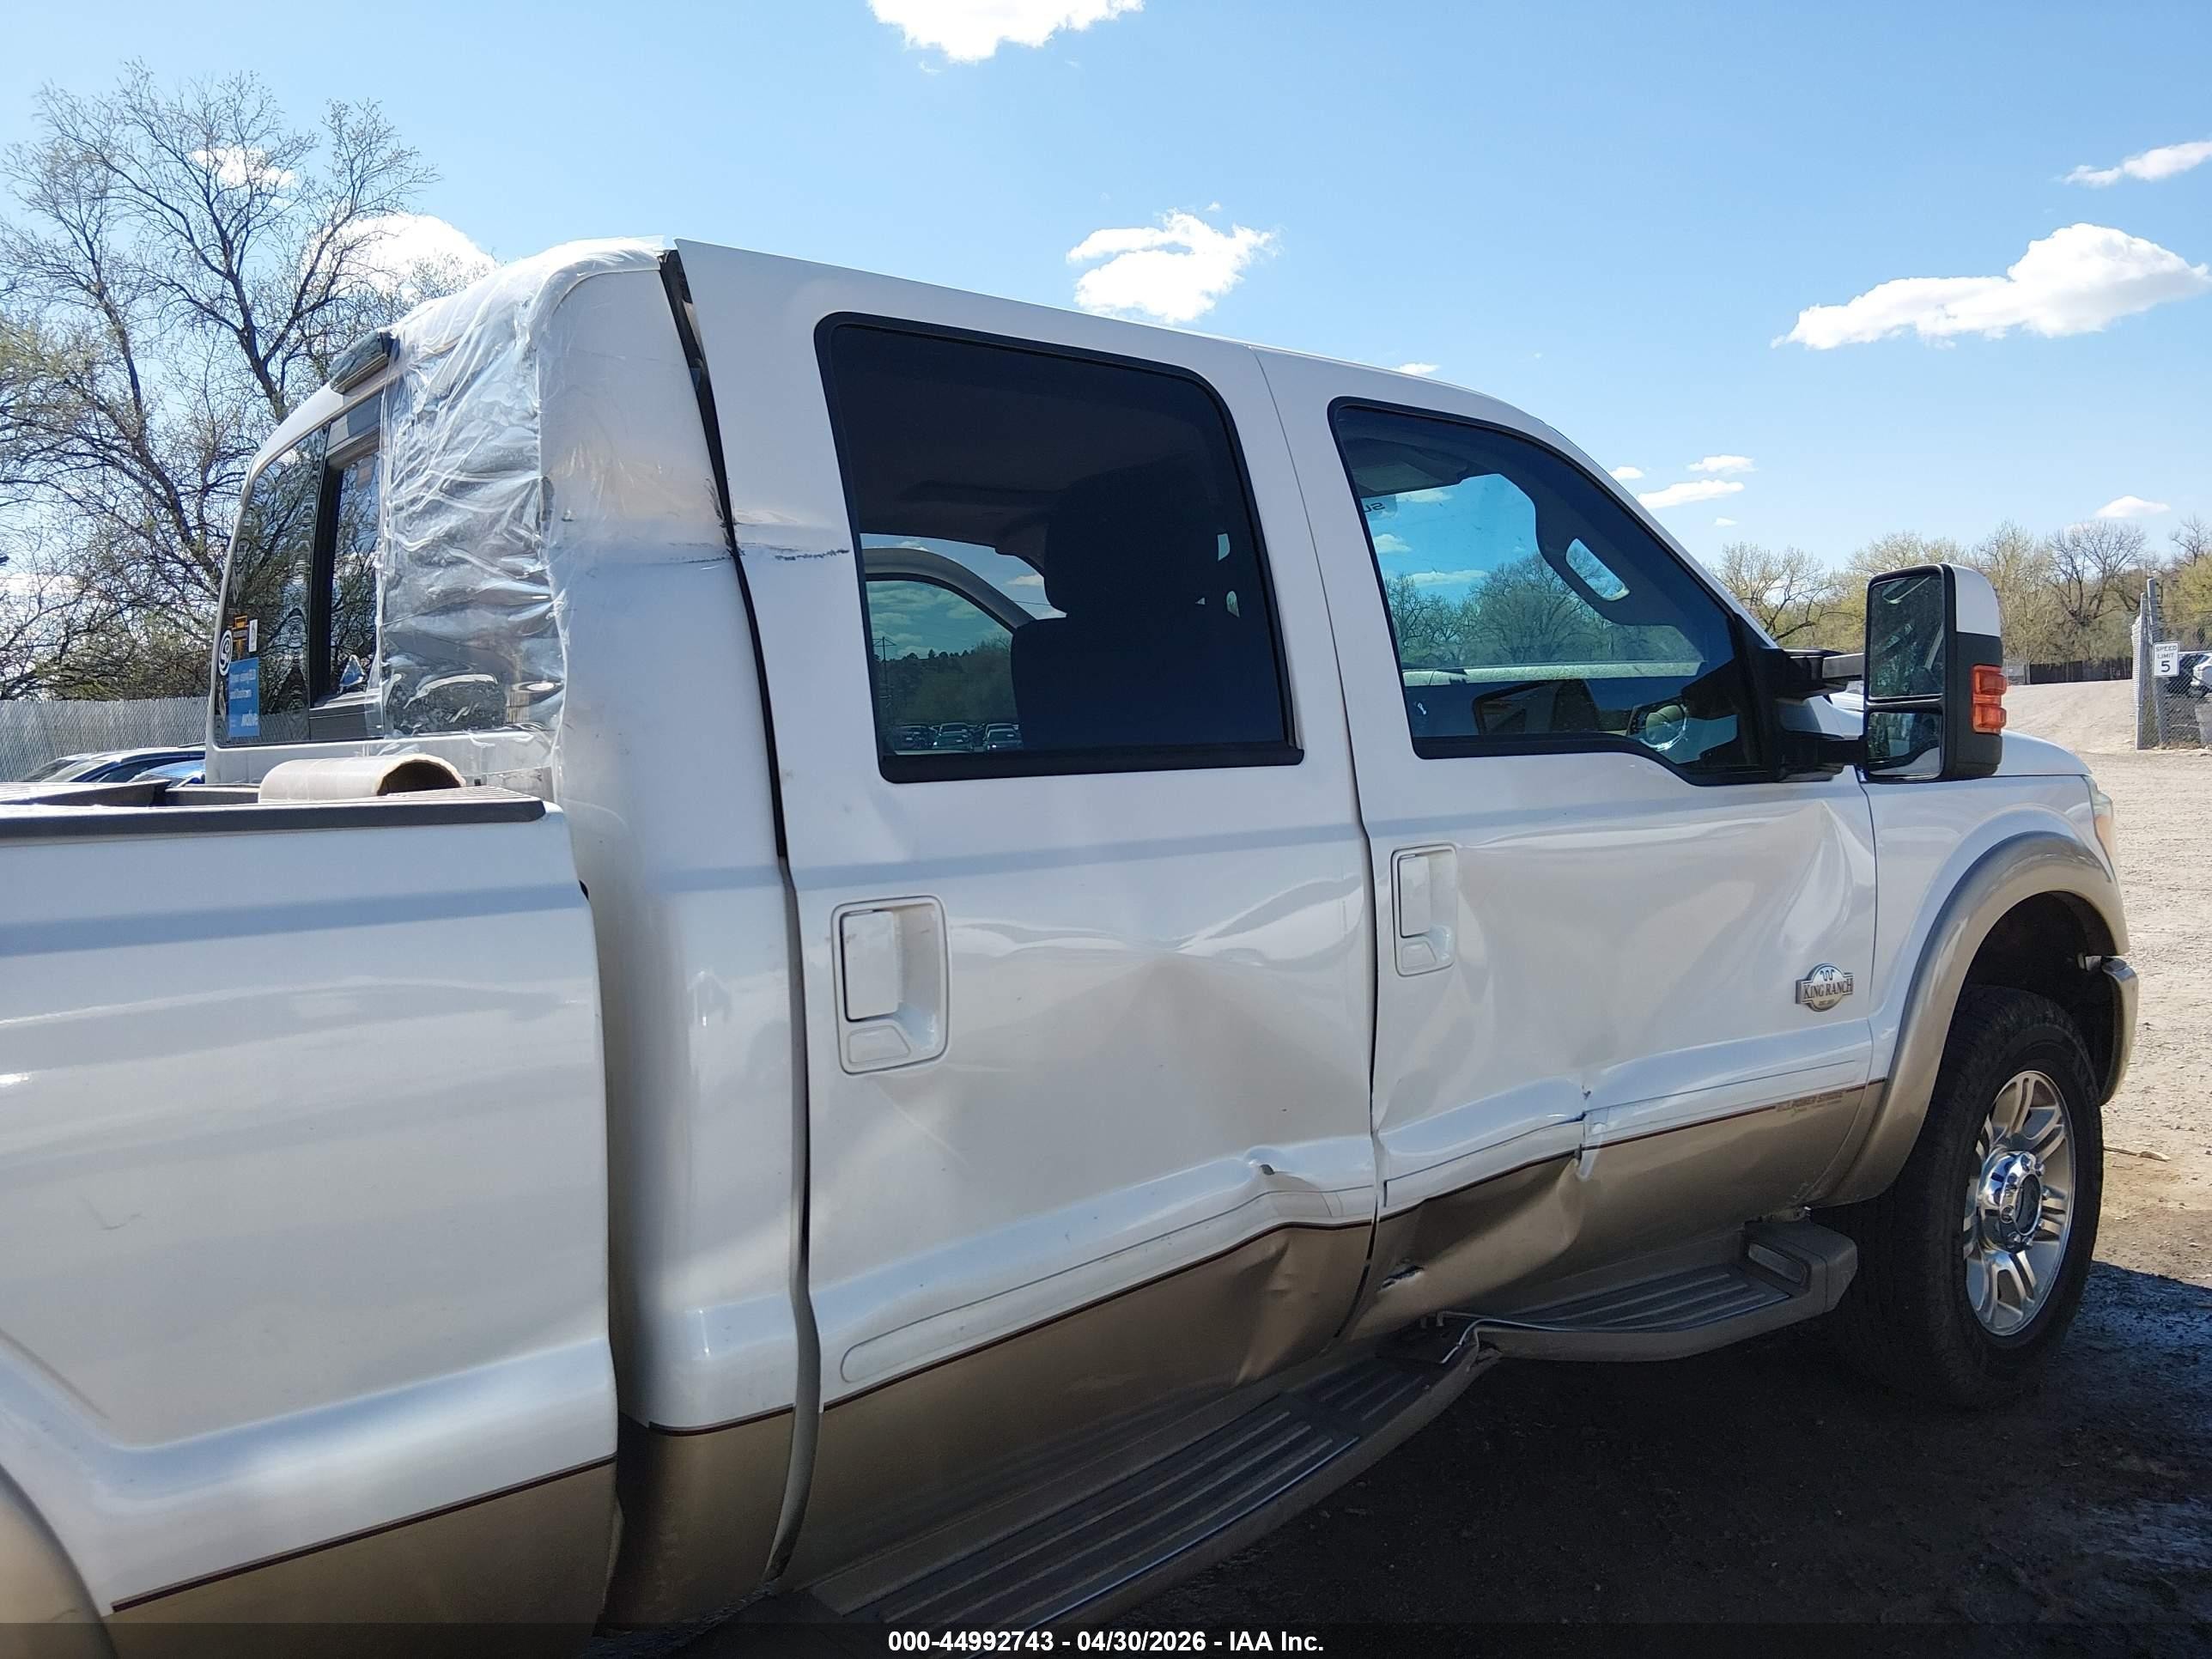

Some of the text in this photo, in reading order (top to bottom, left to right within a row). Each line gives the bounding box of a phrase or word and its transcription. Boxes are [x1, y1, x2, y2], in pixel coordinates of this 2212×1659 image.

[2160, 660, 2171, 672] 5
[1803, 978, 1853, 999] KING RANCH
